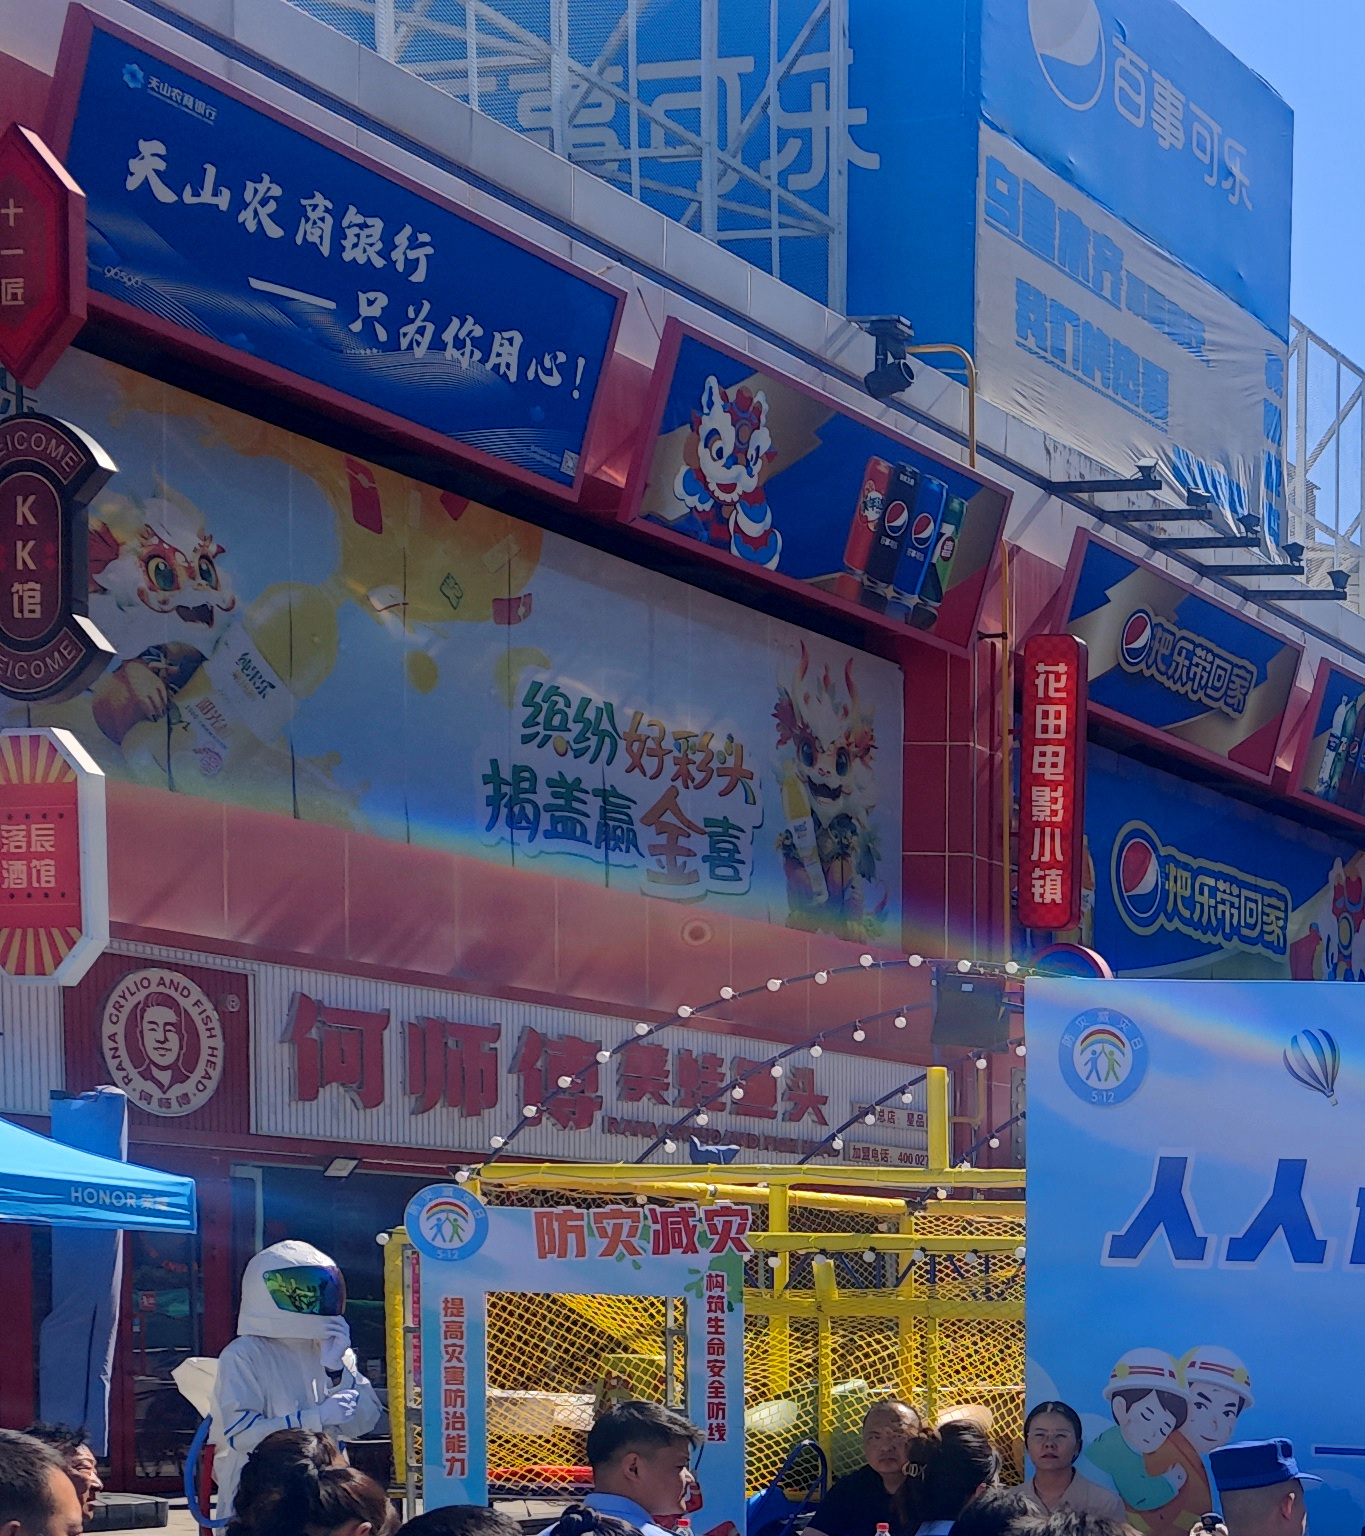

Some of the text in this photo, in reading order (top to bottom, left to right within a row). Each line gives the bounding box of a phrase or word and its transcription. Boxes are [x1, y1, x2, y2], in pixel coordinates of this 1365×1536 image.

[147, 76, 217, 120] 天山农商银行
[1112, 36, 1255, 213] 百事可乐
[1, 198, 25, 305] 十一匠
[125, 138, 436, 283] 天山农商银行
[1148, 626, 1258, 716] 把乐带回家
[520, 679, 758, 807] 缤纷好彩头
[1030, 662, 1069, 905] 花田电影小镇
[1, 823, 56, 854] 落辰
[1, 859, 57, 889] 酒馆
[481, 757, 754, 887] 揭盖赢金喜
[1164, 861, 1289, 950] 把乐带回家
[108, 974, 219, 1093] RANA GRYLIO AND FISH HEAD
[281, 991, 603, 1131] 何师傅
[70, 1187, 137, 1208] HONOR
[533, 1204, 754, 1259] 防灾减灾
[442, 1297, 467, 1477] 提高灾害防治能力
[706, 1272, 728, 1442] 构筑生命安全防线
